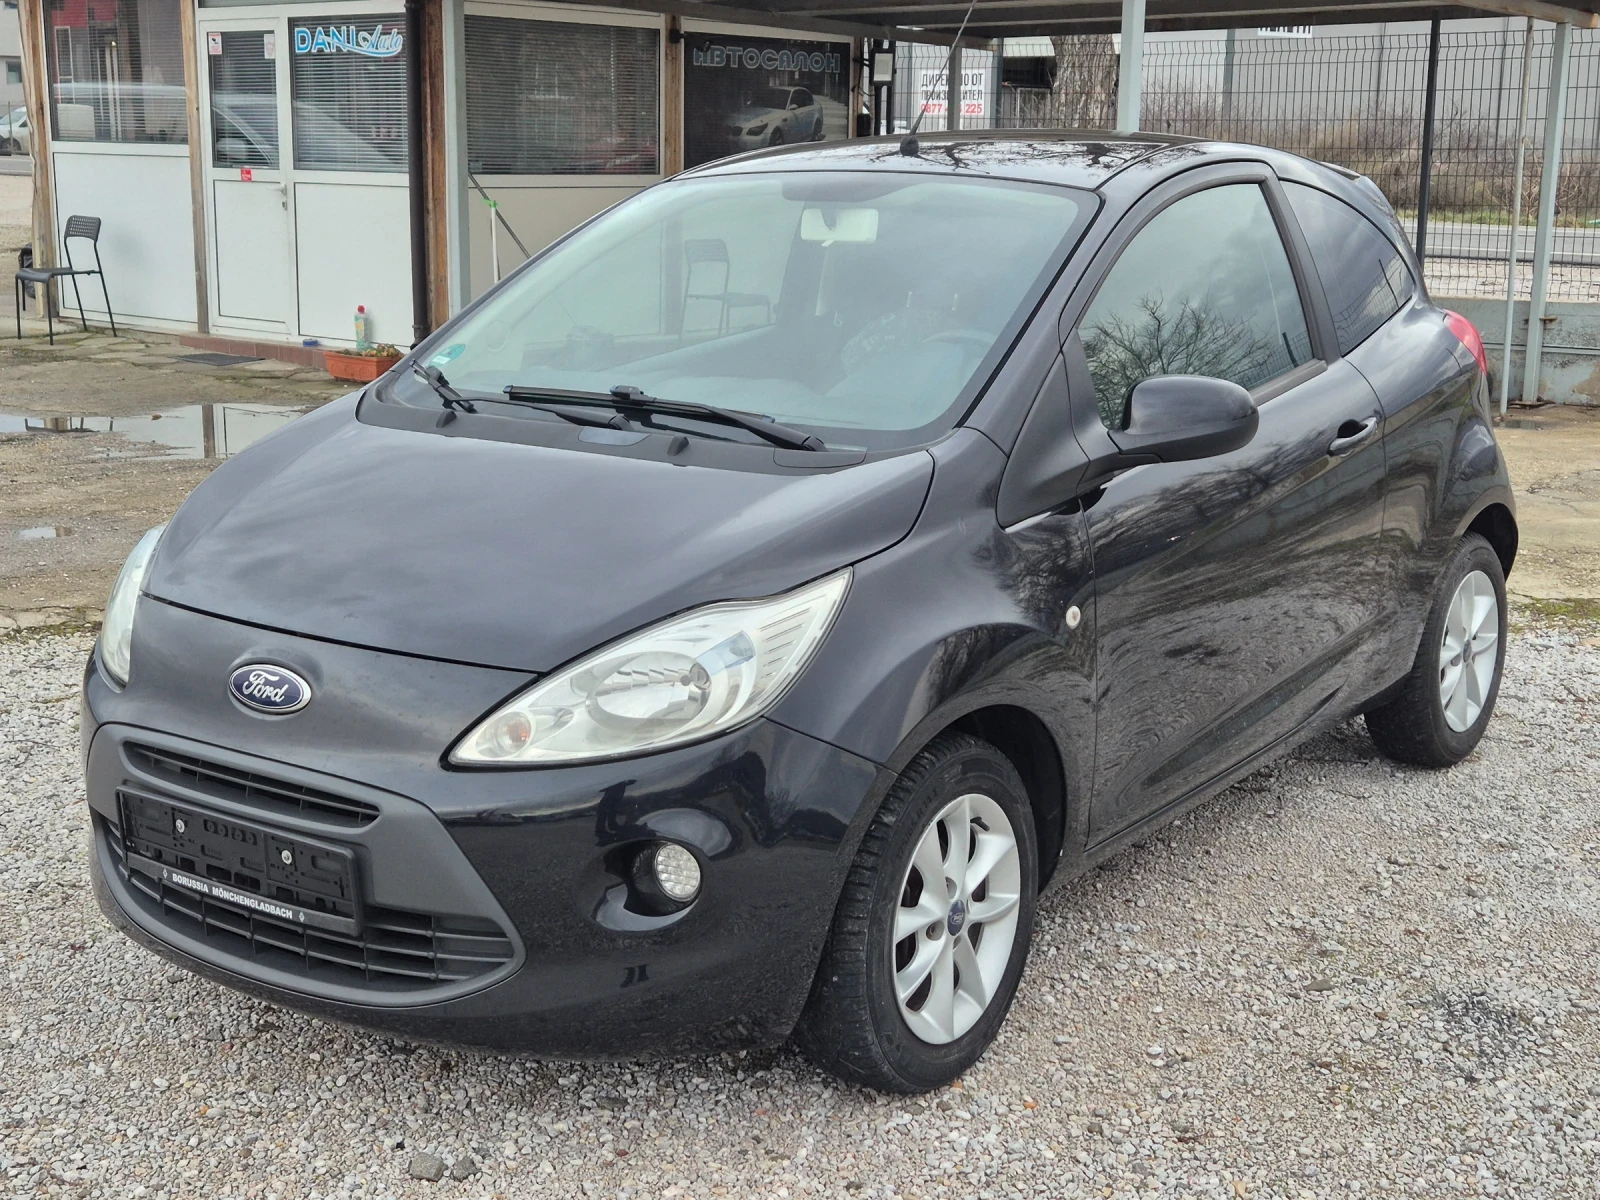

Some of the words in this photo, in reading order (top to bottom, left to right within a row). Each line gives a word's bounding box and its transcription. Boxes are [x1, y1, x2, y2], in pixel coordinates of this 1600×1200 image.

[294, 25, 356, 53] DANI
[357, 24, 403, 53] Auto
[693, 45, 840, 73] АВТОСАЛОН
[921, 73, 970, 87] ДИРЕО
[971, 73, 983, 86] ОТ
[965, 103, 983, 114] 225
[242, 670, 289, 703] Ford
[172, 873, 209, 893] BORUSSIA
[212, 886, 293, 919] MÖNCHENGLADBACH
